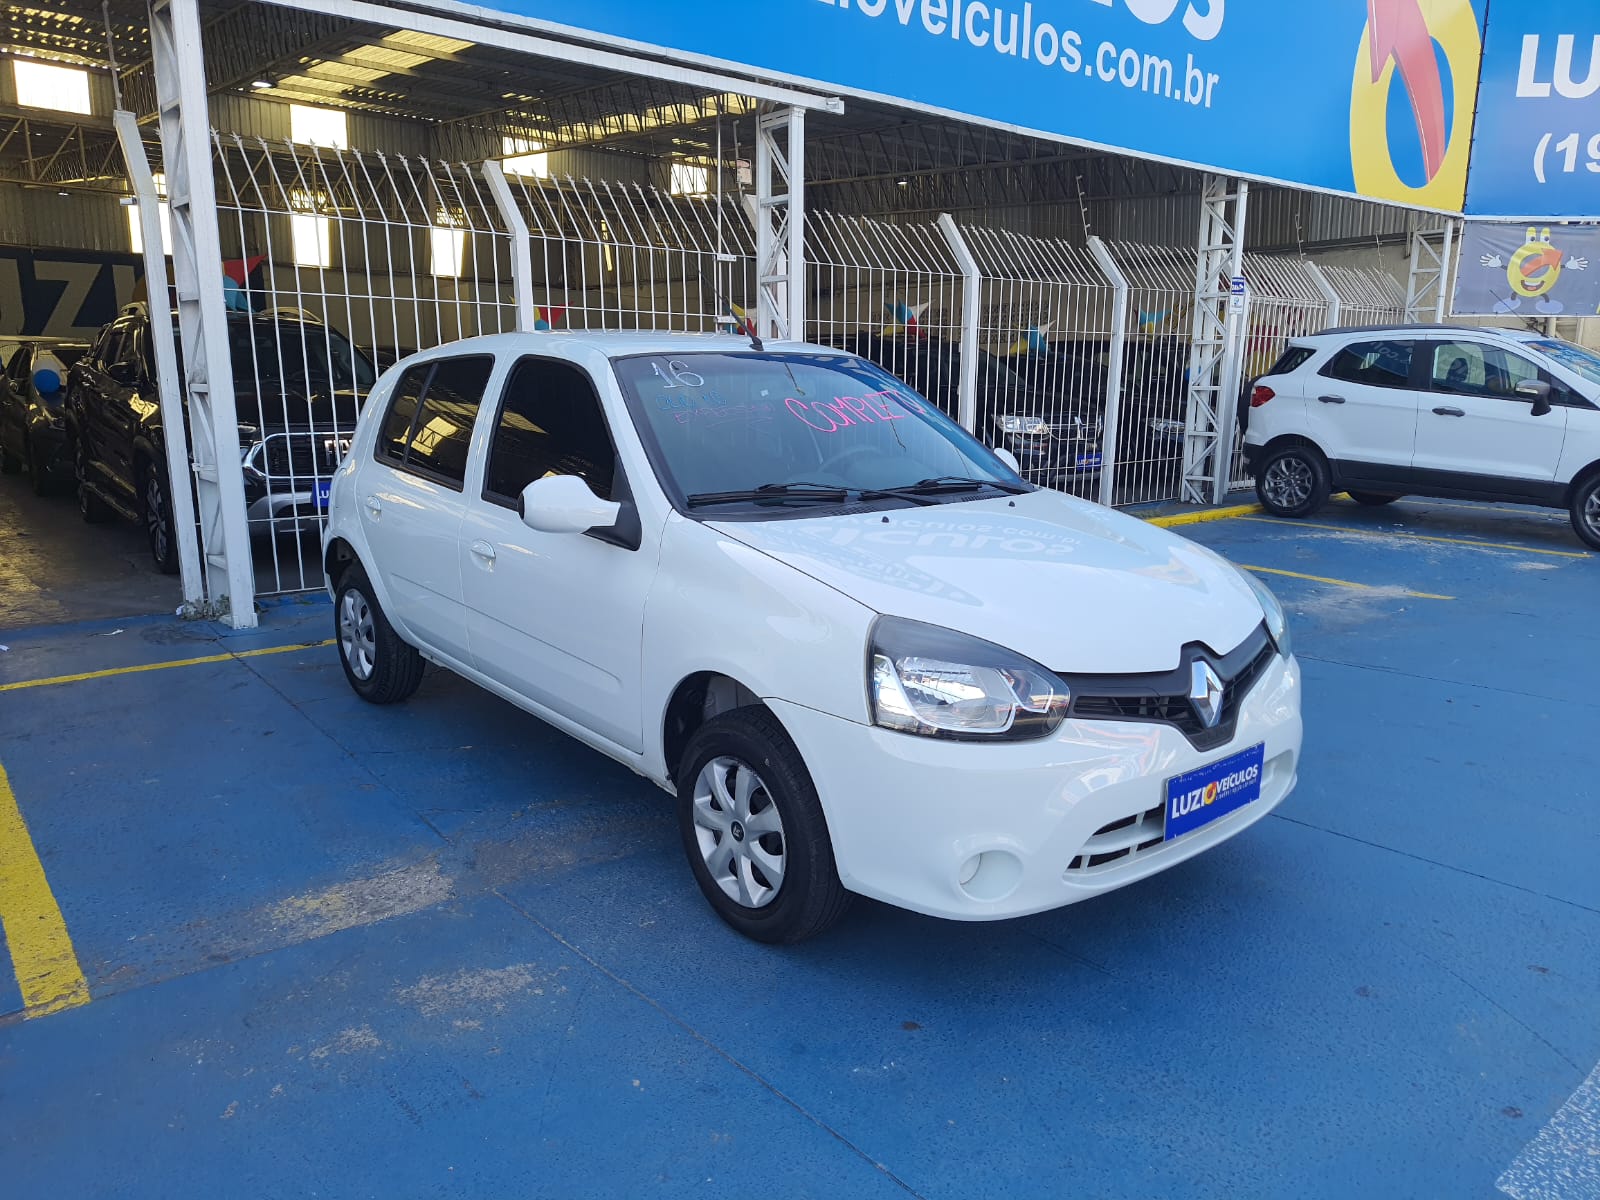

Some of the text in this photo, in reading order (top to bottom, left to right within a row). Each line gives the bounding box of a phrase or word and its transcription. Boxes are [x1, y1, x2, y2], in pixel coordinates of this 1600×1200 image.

[651, 360, 704, 388] 16
[1171, 782, 1217, 819] LUZIO
[1216, 764, 1259, 794] VEÍCULOS
